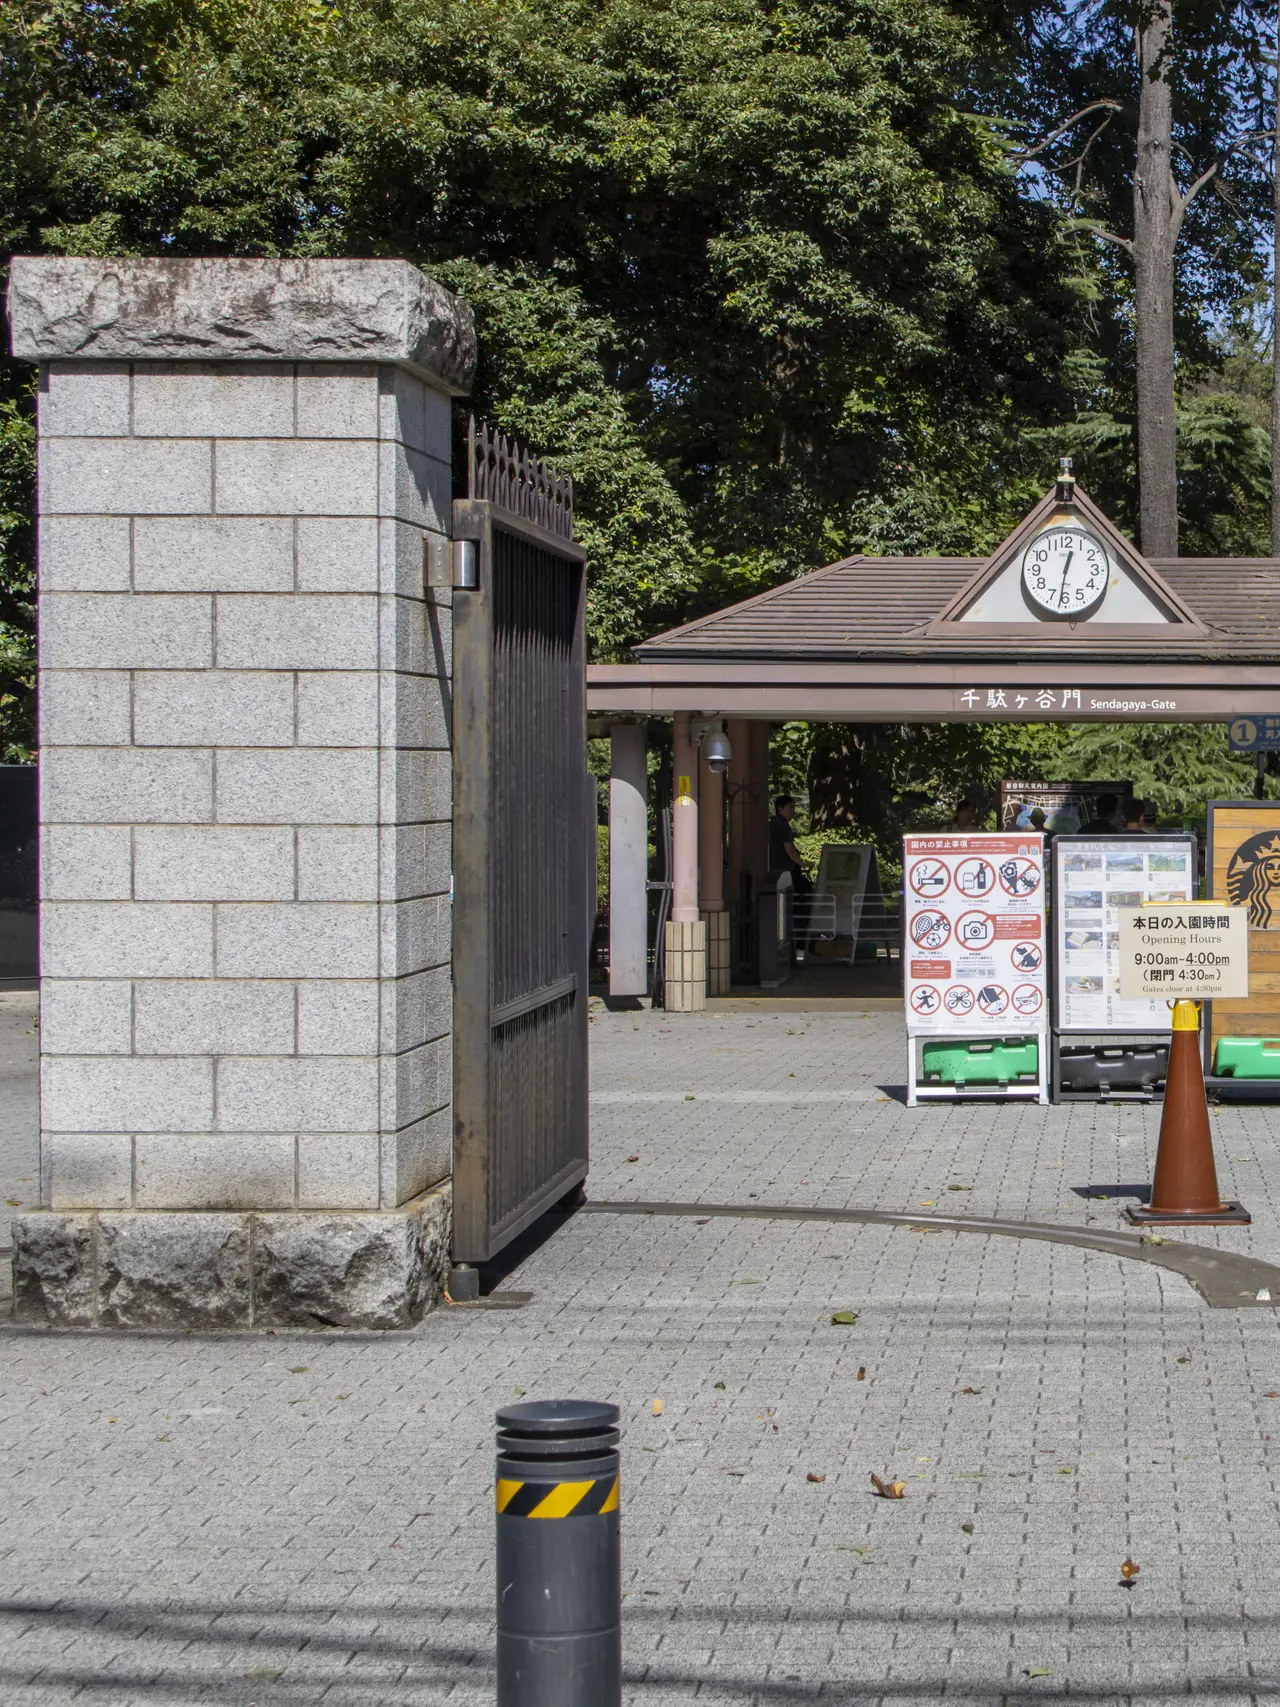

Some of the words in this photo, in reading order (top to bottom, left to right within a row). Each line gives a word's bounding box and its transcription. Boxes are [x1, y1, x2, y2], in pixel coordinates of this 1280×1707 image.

[1048, 539, 1058, 551] 11
[1060, 536, 1073, 548] 12
[1079, 539, 1083, 551] 1
[1036, 549, 1048, 562] 10
[1086, 549, 1096, 561] 2
[1031, 564, 1041, 576] 9
[1090, 564, 1099, 576] 3
[1036, 577, 1046, 589] 8
[1086, 578, 1095, 589] 4
[1048, 589, 1057, 600] 7
[1061, 592, 1070, 604] 6
[1075, 589, 1084, 600] 5
[1090, 699, 1176, 711] Sendagaya-Gate
[911, 840, 968, 849] 園内の禁止事項
[1132, 915, 1230, 929] 本日の入園時間
[1141, 934, 1186, 945] Opening
[1190, 934, 1222, 944] Hours
[1195, 985, 1222, 993] 4:30pm
